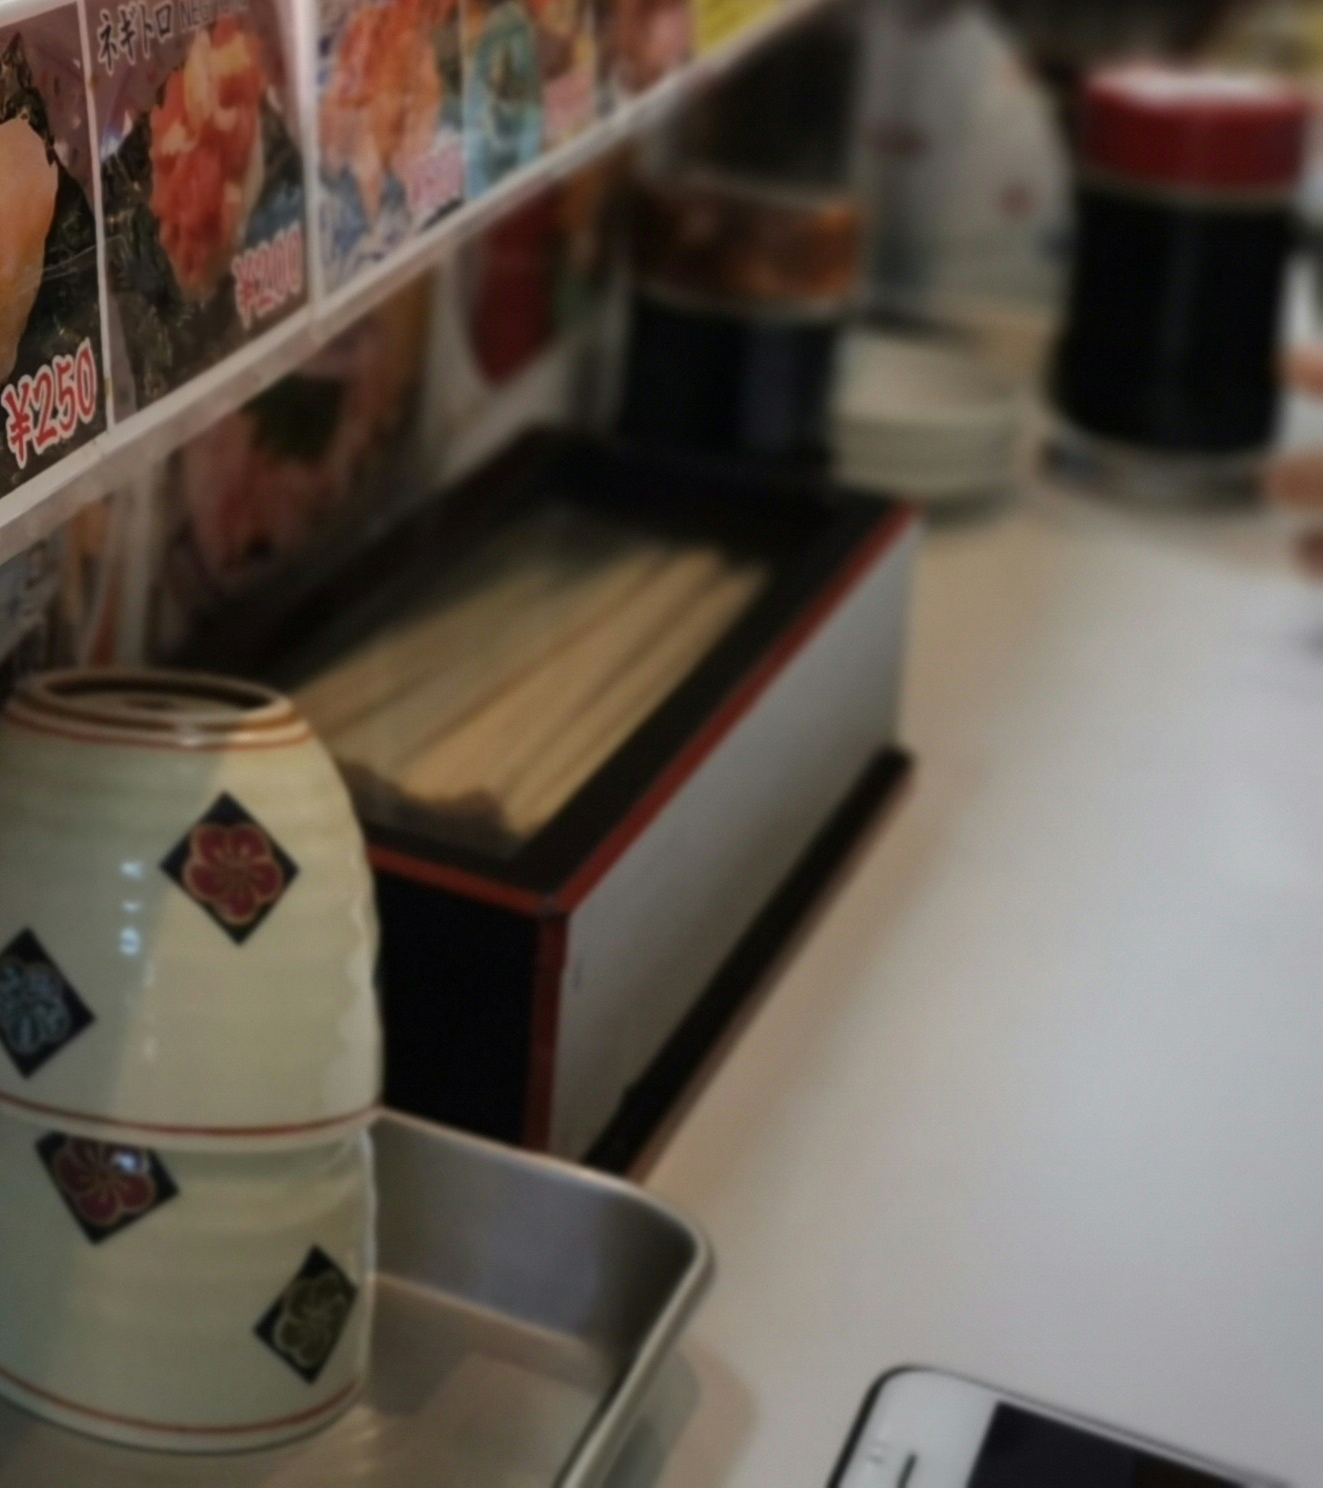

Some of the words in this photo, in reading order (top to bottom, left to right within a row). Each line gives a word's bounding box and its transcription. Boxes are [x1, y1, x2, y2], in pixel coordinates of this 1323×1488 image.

[98, 0, 173, 75] ネギトロ
[1, 340, 97, 469] ¥250
